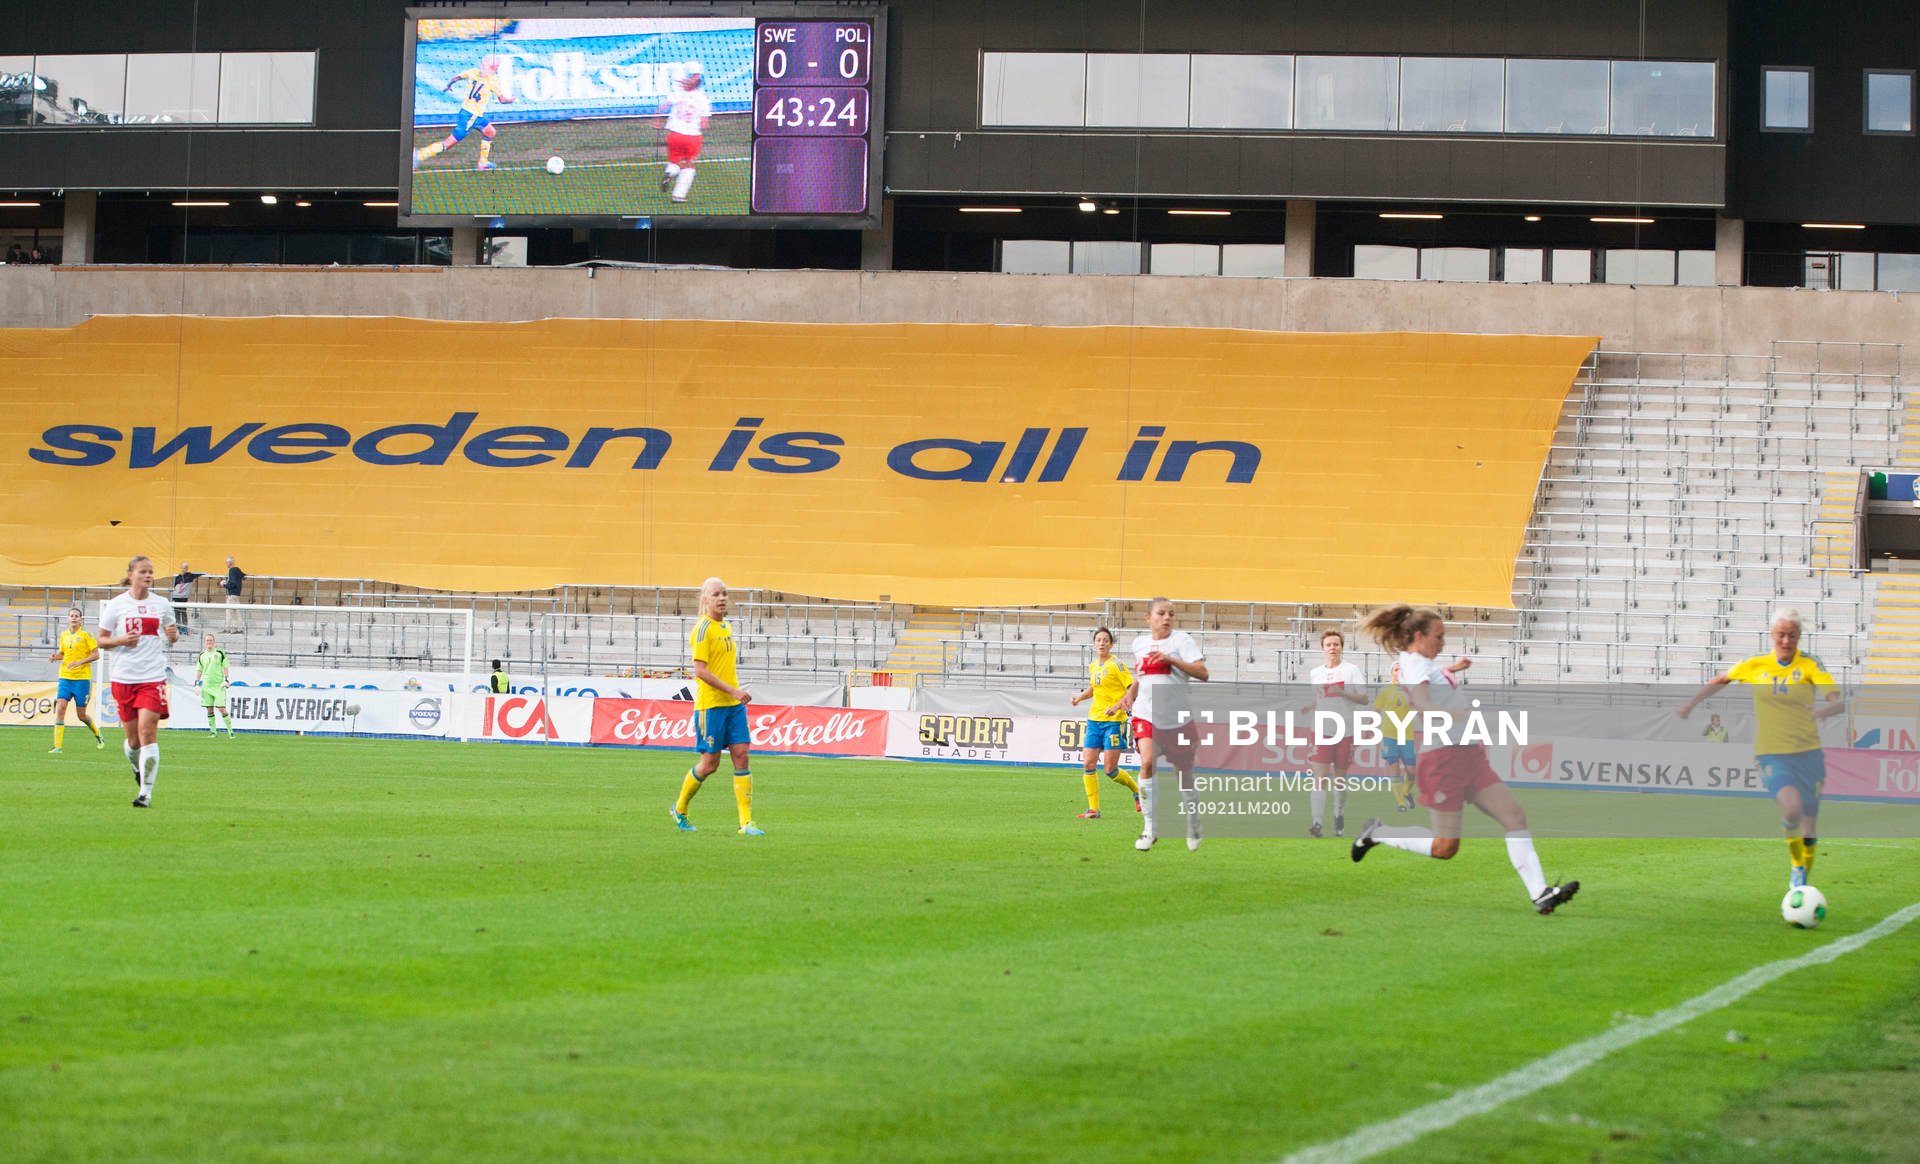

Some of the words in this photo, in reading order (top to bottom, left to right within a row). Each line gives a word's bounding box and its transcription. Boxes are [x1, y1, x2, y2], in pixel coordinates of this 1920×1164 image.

[764, 28, 796, 43] SWE
[836, 28, 866, 43] POL
[768, 49, 787, 79] 0
[840, 49, 859, 79] 0
[765, 97, 858, 127] 43:24
[28, 412, 672, 470] sweden
[708, 417, 845, 474] is
[887, 427, 1088, 484] all
[1116, 425, 1262, 484] in
[126, 618, 142, 634] 13
[1772, 676, 1788, 695] 14
[0, 693, 57, 719] väge
[230, 697, 269, 720] HEJA
[275, 698, 347, 721] SVERIGE!
[483, 697, 559, 739] ICA
[614, 708, 697, 740] Estrel
[749, 711, 866, 747] Estrella
[919, 715, 1013, 749] SPORT
[922, 747, 1008, 759] BLADET
[1560, 759, 1693, 787] SVENSKA
[1708, 766, 1770, 789] SPE
